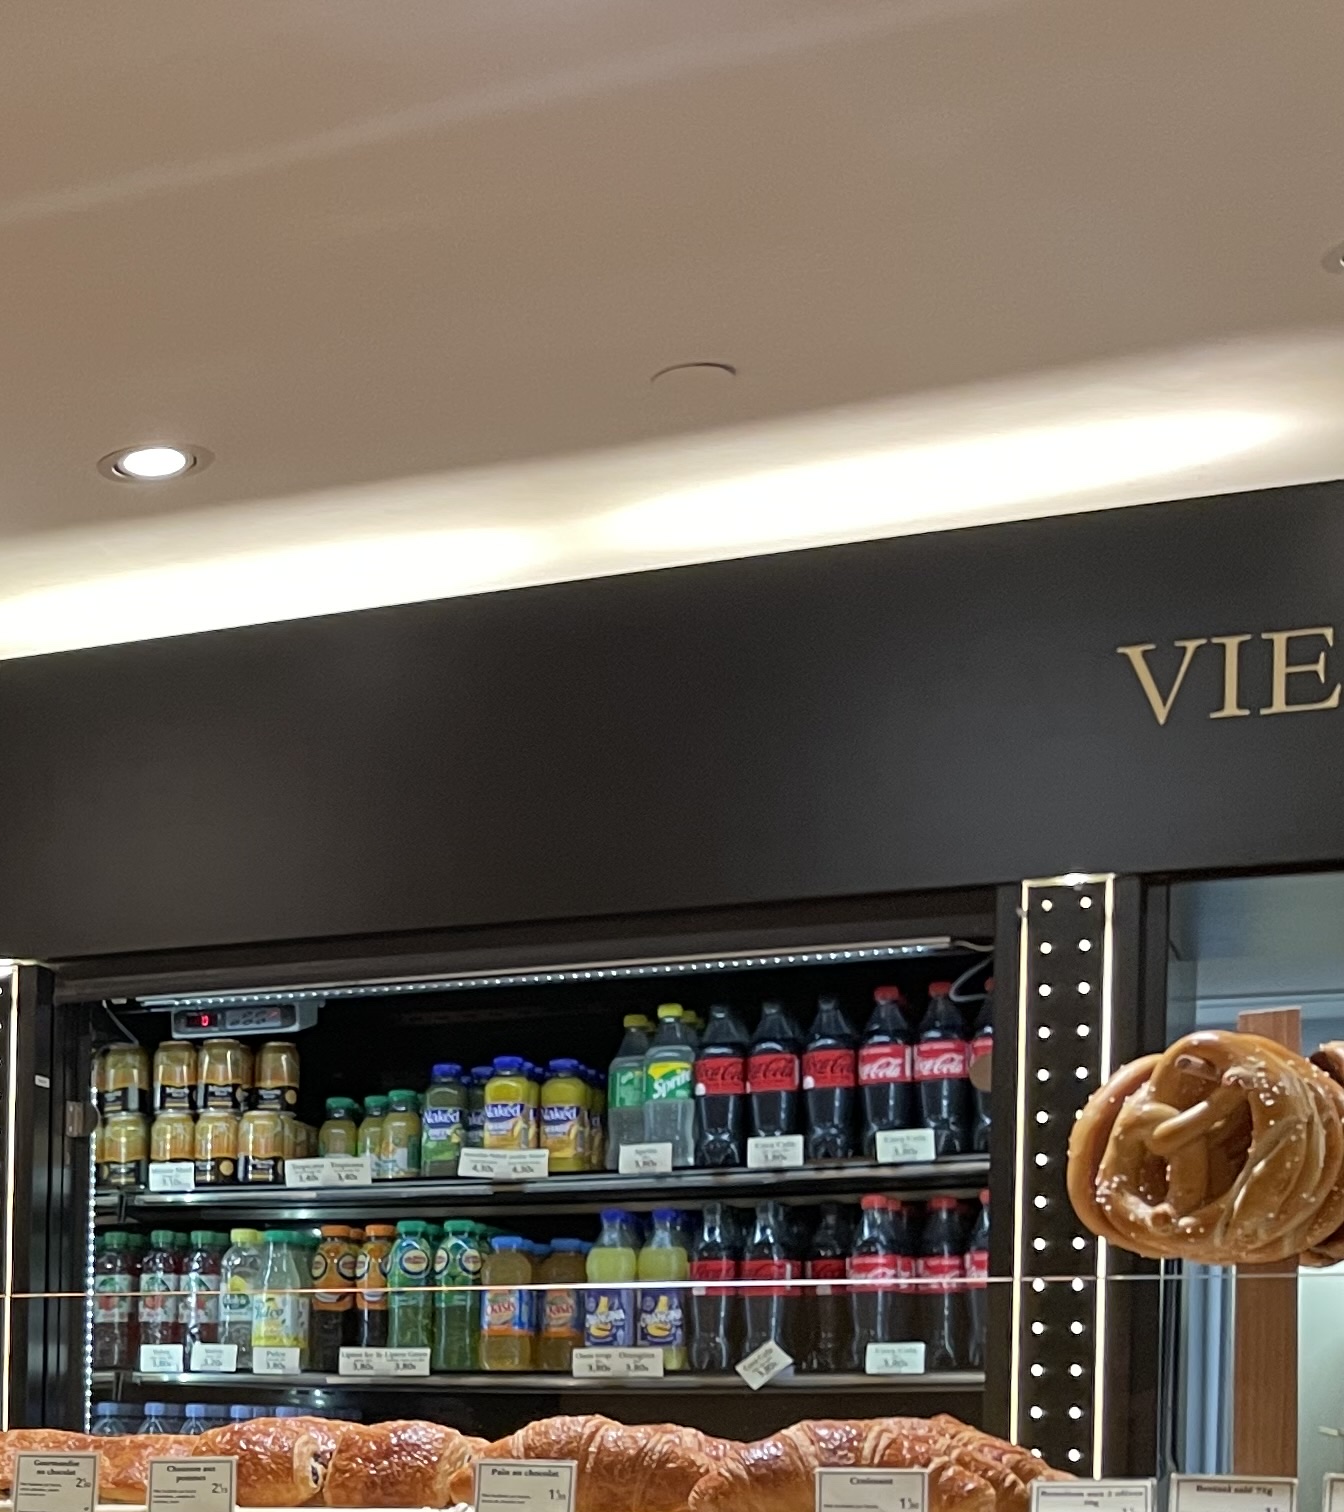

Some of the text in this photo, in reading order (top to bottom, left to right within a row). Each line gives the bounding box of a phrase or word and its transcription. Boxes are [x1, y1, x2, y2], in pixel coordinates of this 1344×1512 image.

[1116, 626, 1342, 726] VIE
[491, 1468, 510, 1476] Pain
[524, 1469, 560, 1478] chocolat
